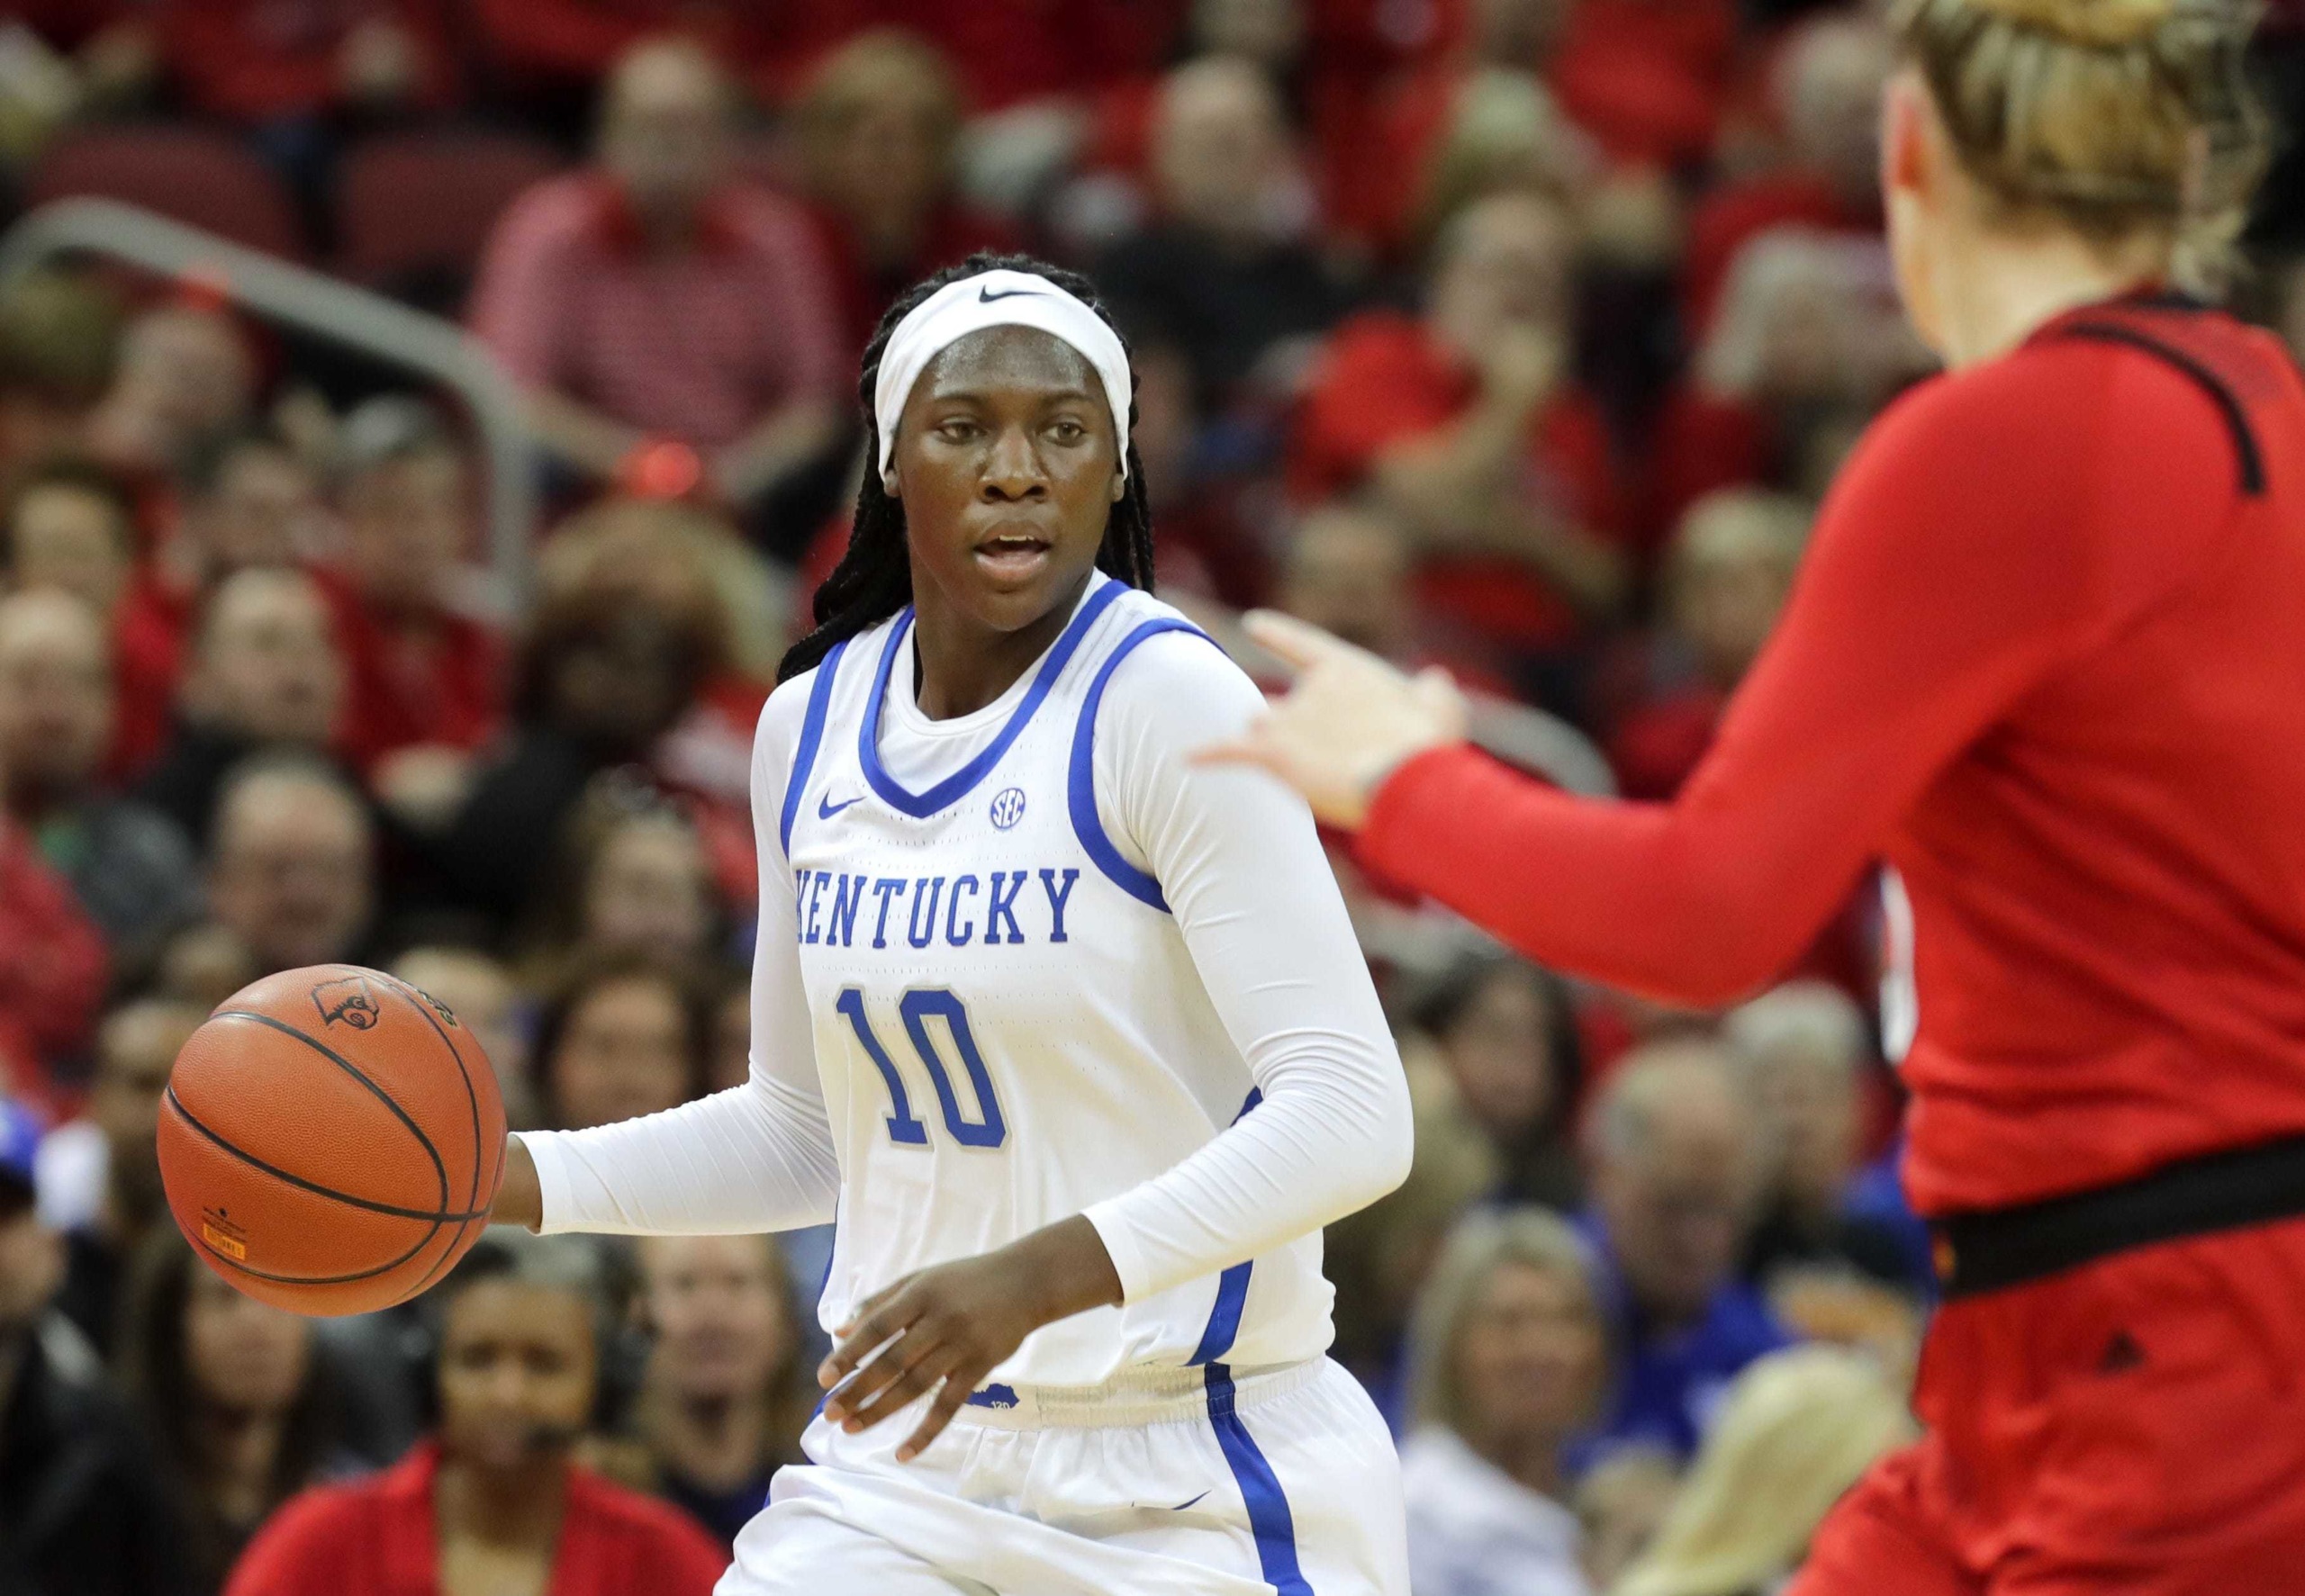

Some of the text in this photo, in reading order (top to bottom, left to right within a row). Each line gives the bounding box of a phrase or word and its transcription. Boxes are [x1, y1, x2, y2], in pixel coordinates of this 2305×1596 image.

[991, 789, 1025, 828] SEC
[796, 869, 1080, 949] KENTUCKY
[835, 987, 1008, 1150] 10
